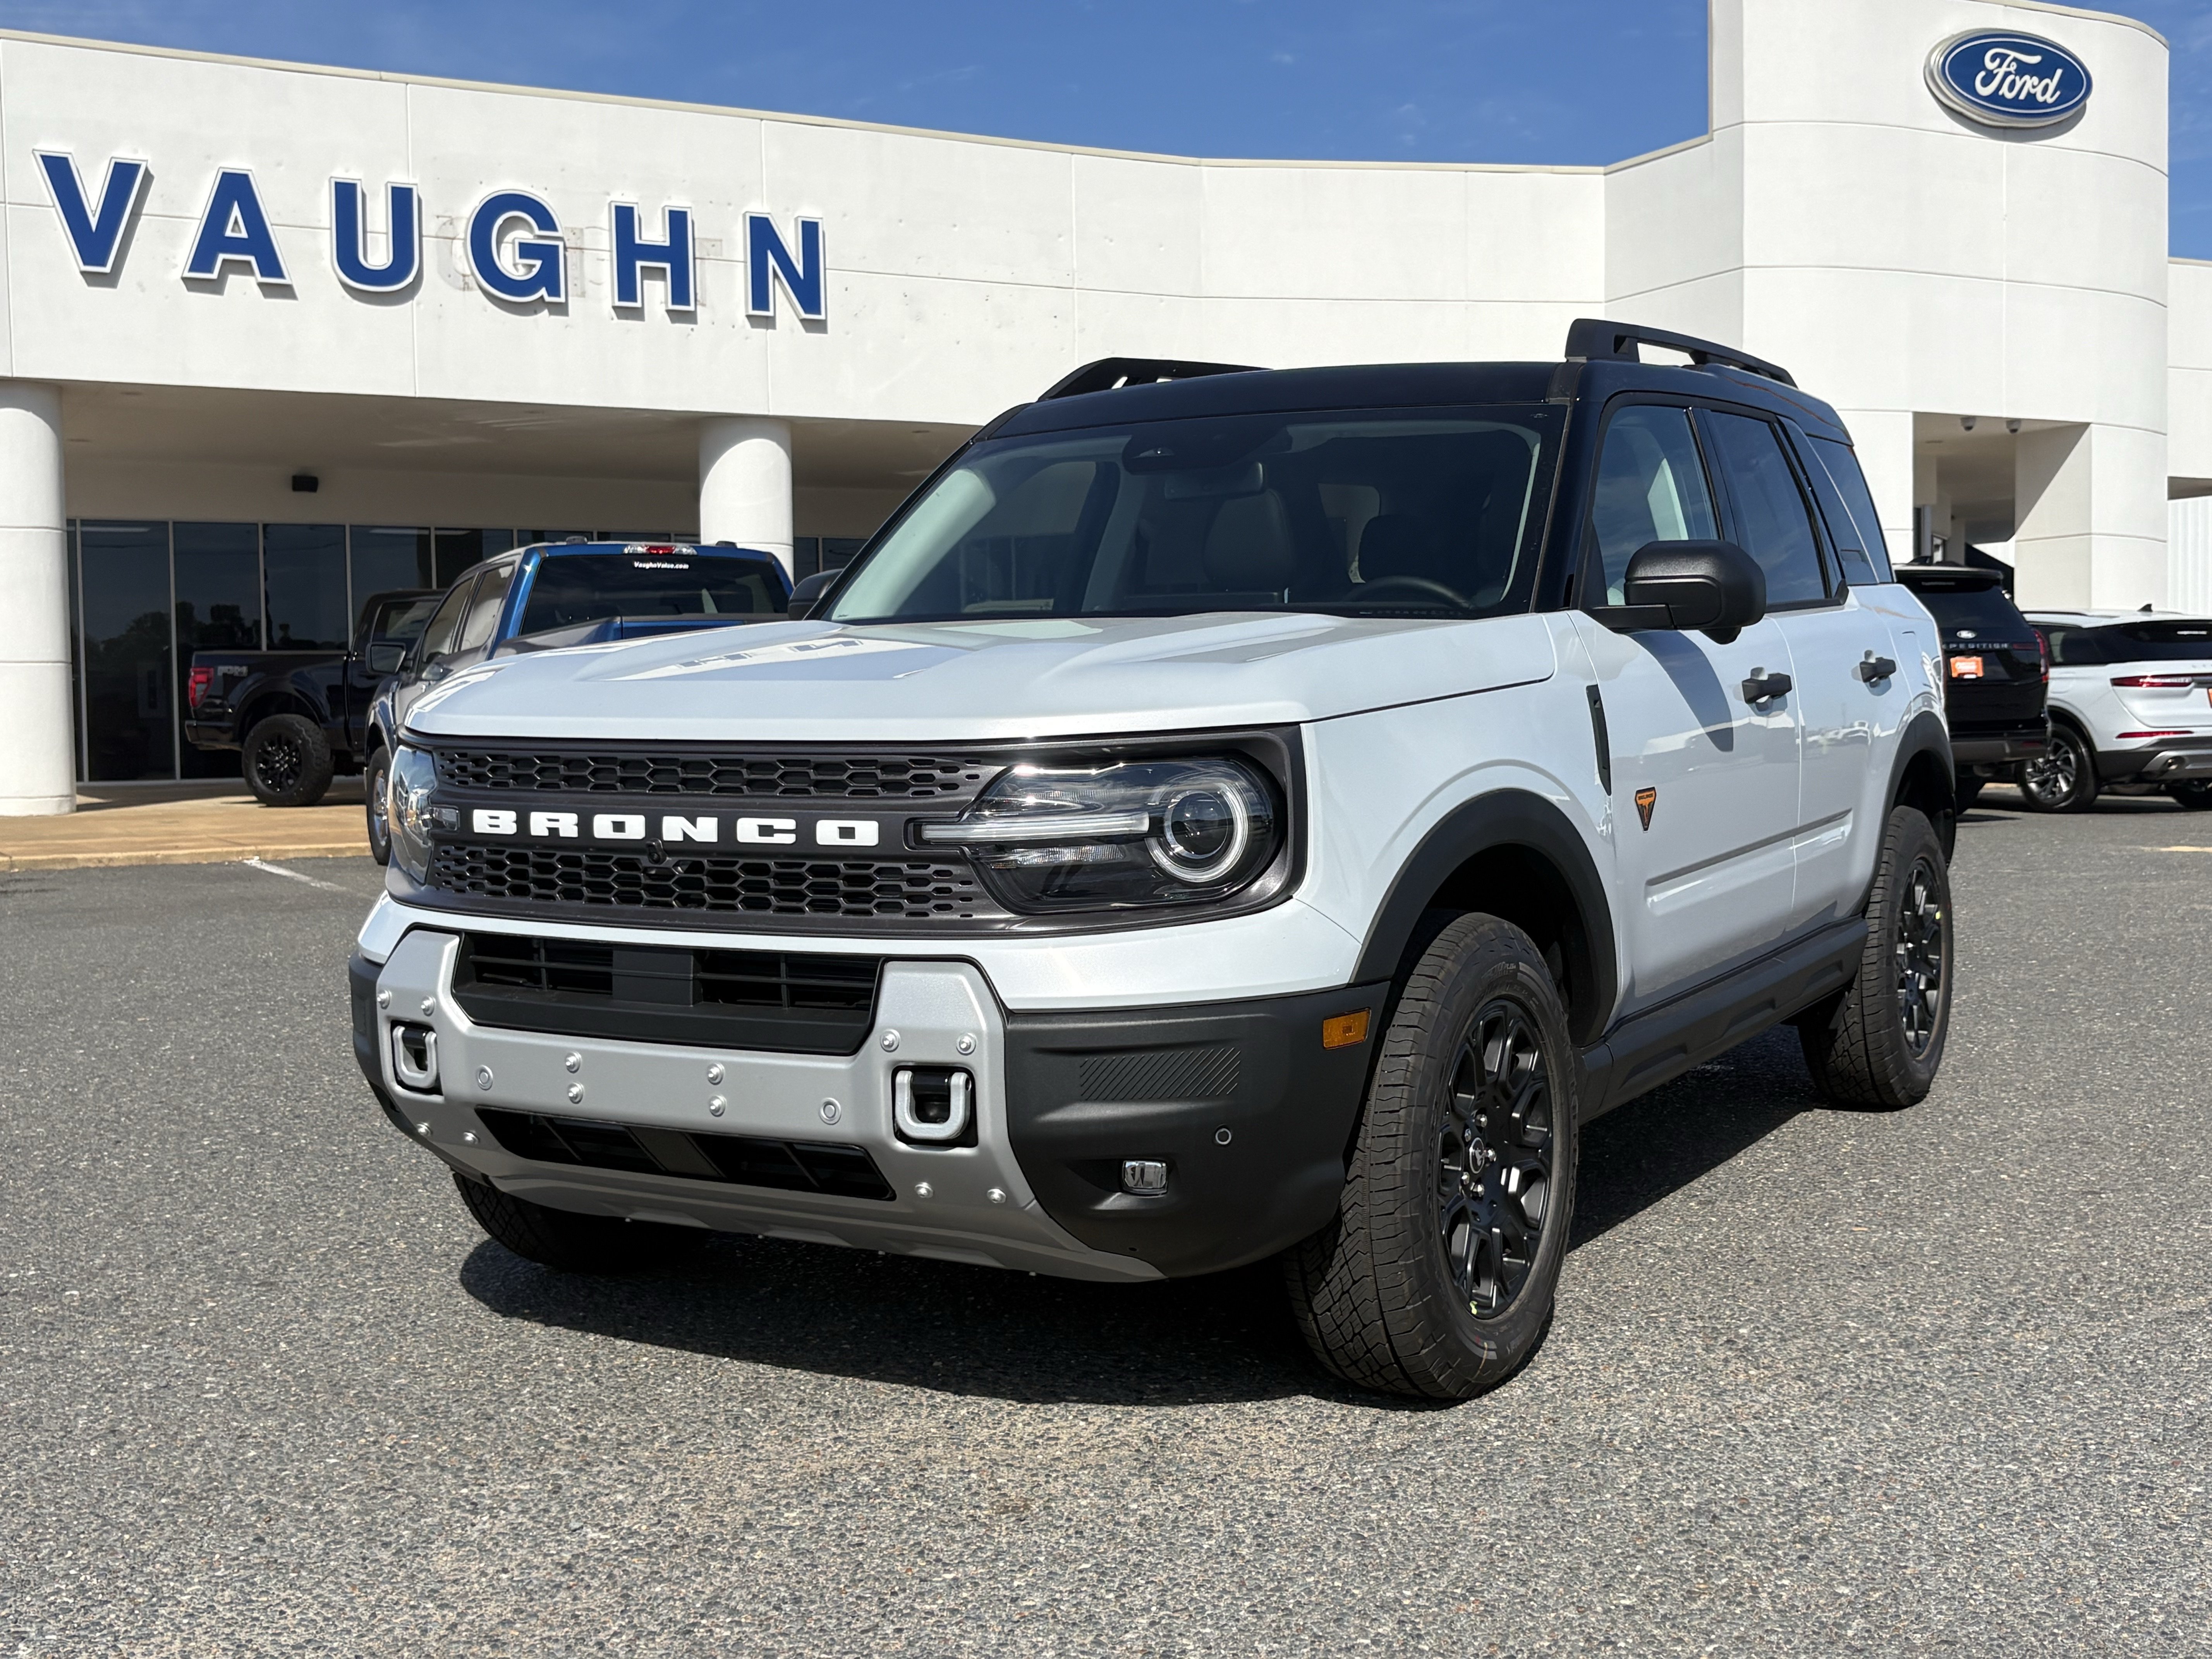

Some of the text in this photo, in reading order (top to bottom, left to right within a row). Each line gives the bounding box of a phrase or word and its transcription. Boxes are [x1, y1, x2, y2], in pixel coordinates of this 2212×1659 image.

[1975, 48, 2063, 104] Ford
[33, 148, 826, 321] VAUGHN
[472, 809, 879, 847] BRONCO
